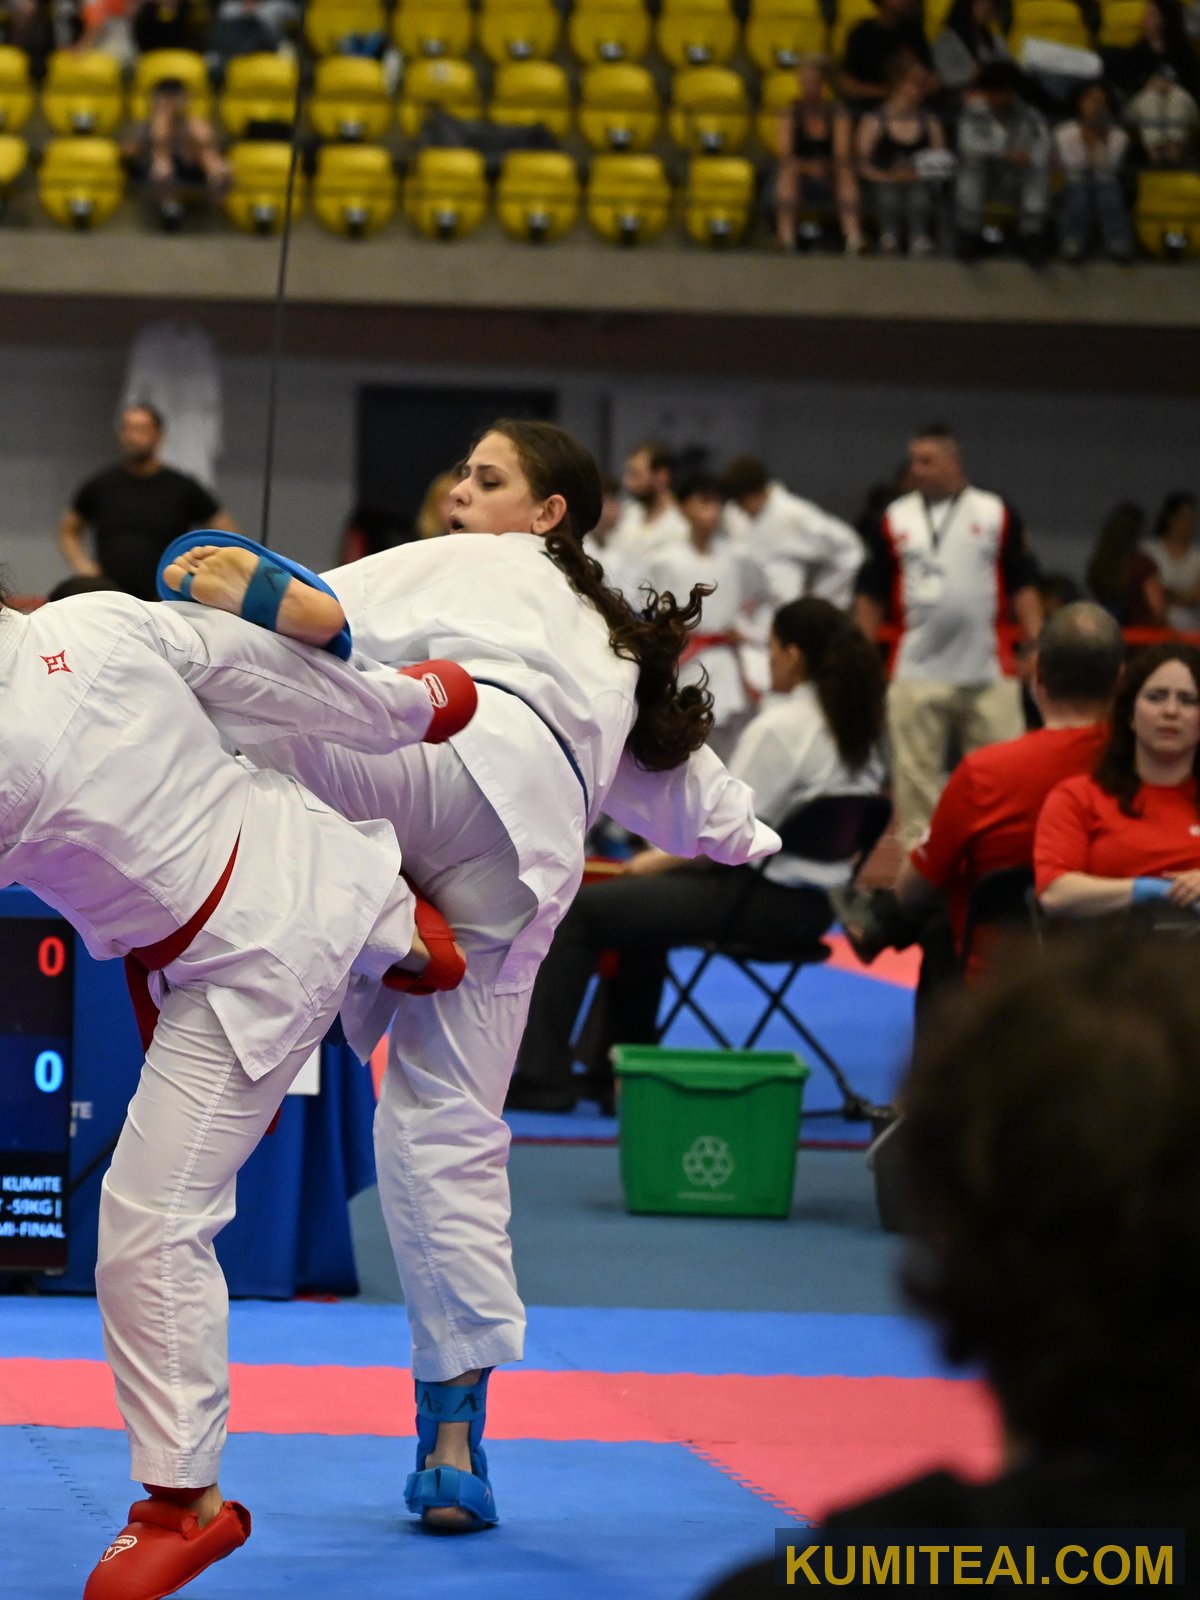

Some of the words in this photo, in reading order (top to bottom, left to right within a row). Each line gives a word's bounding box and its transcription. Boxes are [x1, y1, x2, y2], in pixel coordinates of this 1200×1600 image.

[38, 935, 66, 977] 0
[34, 1050, 64, 1093] 0
[2, 1174, 62, 1193] KUMITE
